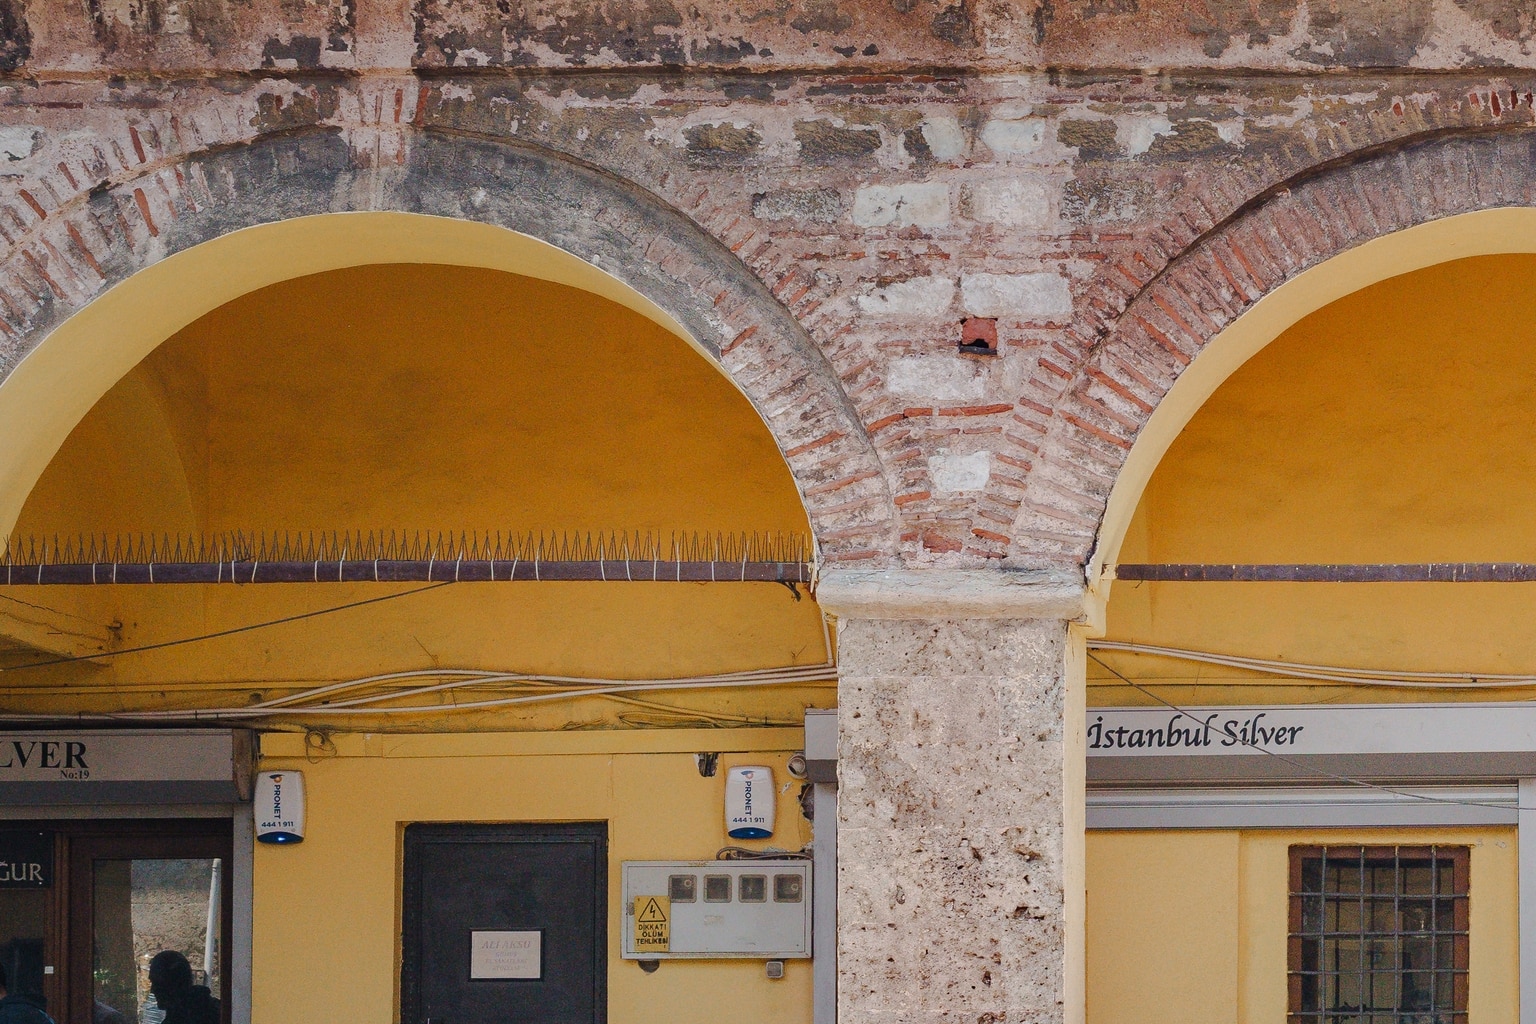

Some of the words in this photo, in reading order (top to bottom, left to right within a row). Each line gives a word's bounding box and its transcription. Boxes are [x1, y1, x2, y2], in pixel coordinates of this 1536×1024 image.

[1087, 713, 1219, 749] İstanbul
[1220, 713, 1304, 747] Silver
[60, 770, 90, 779] No:19
[273, 784, 281, 819] PRONET
